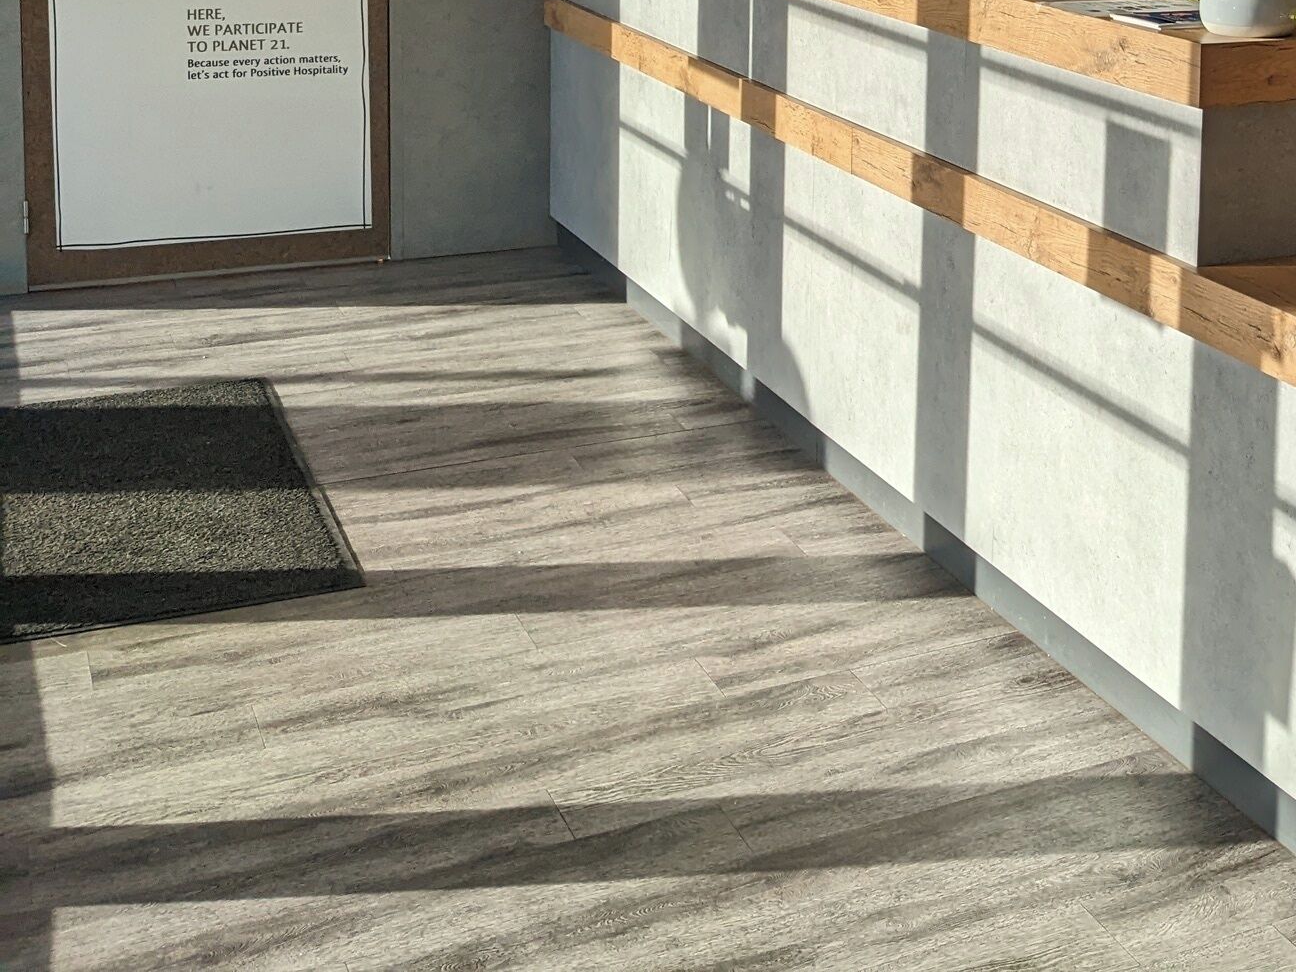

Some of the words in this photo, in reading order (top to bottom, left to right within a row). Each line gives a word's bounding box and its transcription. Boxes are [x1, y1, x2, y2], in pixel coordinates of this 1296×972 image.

[187, 9, 225, 20] HERE,
[188, 25, 210, 36] WE
[215, 22, 303, 36] PARTICIPATE
[188, 41, 208, 52] TO
[213, 39, 266, 51] PLANET
[271, 40, 290, 50] 21.
[188, 59, 229, 68] Because
[233, 58, 260, 67] every
[264, 56, 295, 65] action
[299, 55, 341, 63] matters,
[188, 69, 209, 80] let's
[213, 70, 228, 78] act
[232, 69, 247, 78] for
[251, 68, 290, 77] Positive
[294, 65, 348, 76] Hospitality
